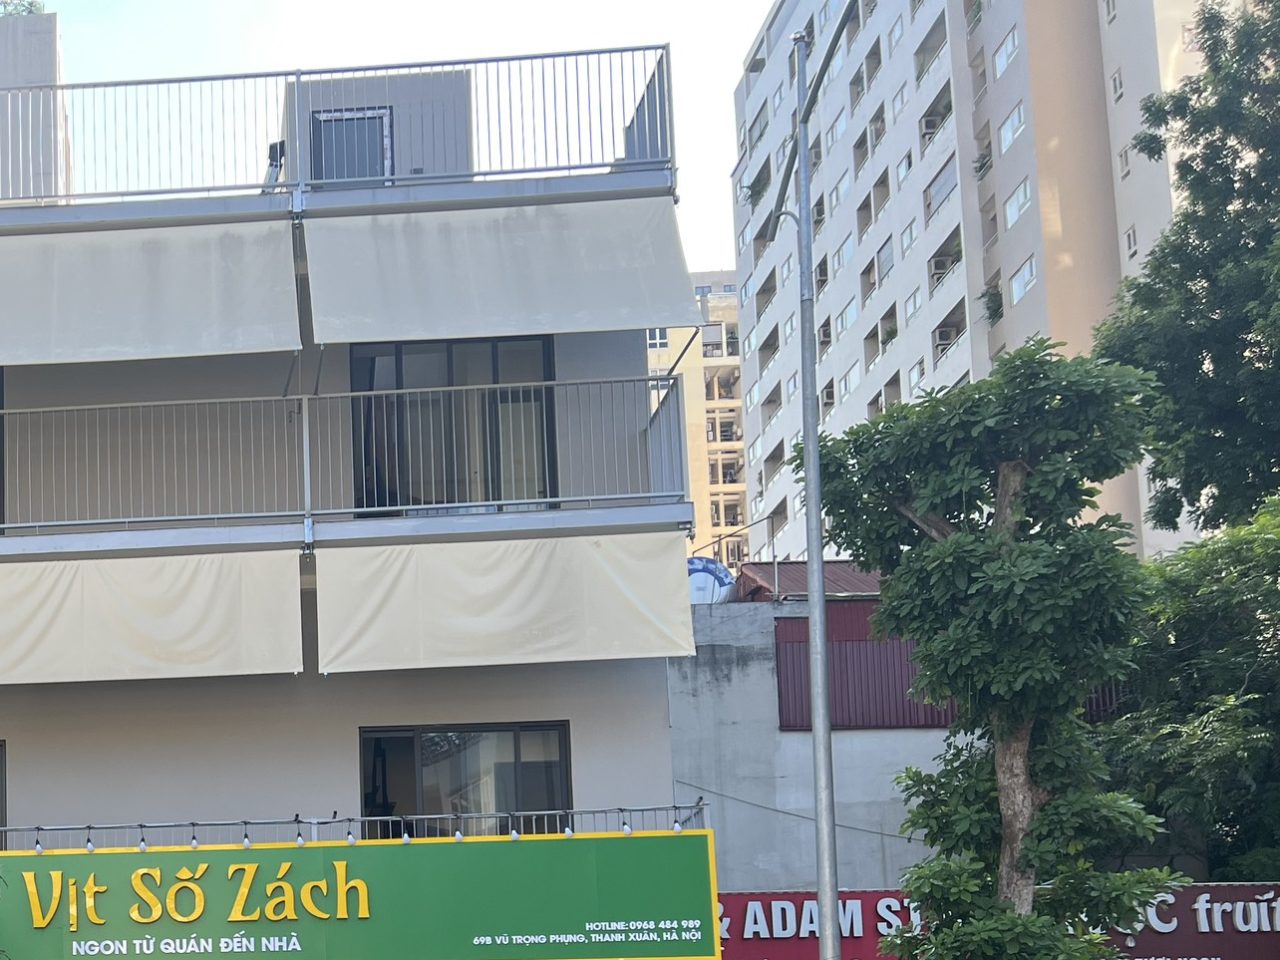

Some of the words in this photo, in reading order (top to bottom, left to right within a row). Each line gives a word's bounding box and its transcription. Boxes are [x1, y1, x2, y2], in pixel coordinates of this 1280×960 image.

[21, 869, 108, 932] Vịt
[128, 862, 209, 924] Số
[226, 860, 371, 922] Zách
[658, 919, 678, 929] 484
[681, 919, 702, 929] 989
[742, 899, 864, 939] ADAM
[72, 939, 128, 957] NGON
[133, 934, 156, 954] TỪ
[160, 934, 213, 954] QUÁN
[219, 930, 256, 952] ĐẾN
[261, 931, 303, 952] NHÀ
[472, 935, 493, 945] 69B
[495, 934, 510, 945] VŨ
[511, 935, 547, 947] TRỌNG
[549, 933, 589, 946] PHỤNG,
[590, 932, 626, 943] THANH
[628, 929, 661, 942] XUÂN,
[663, 930, 679, 941] HÀ
[681, 929, 702, 943] NỘI
